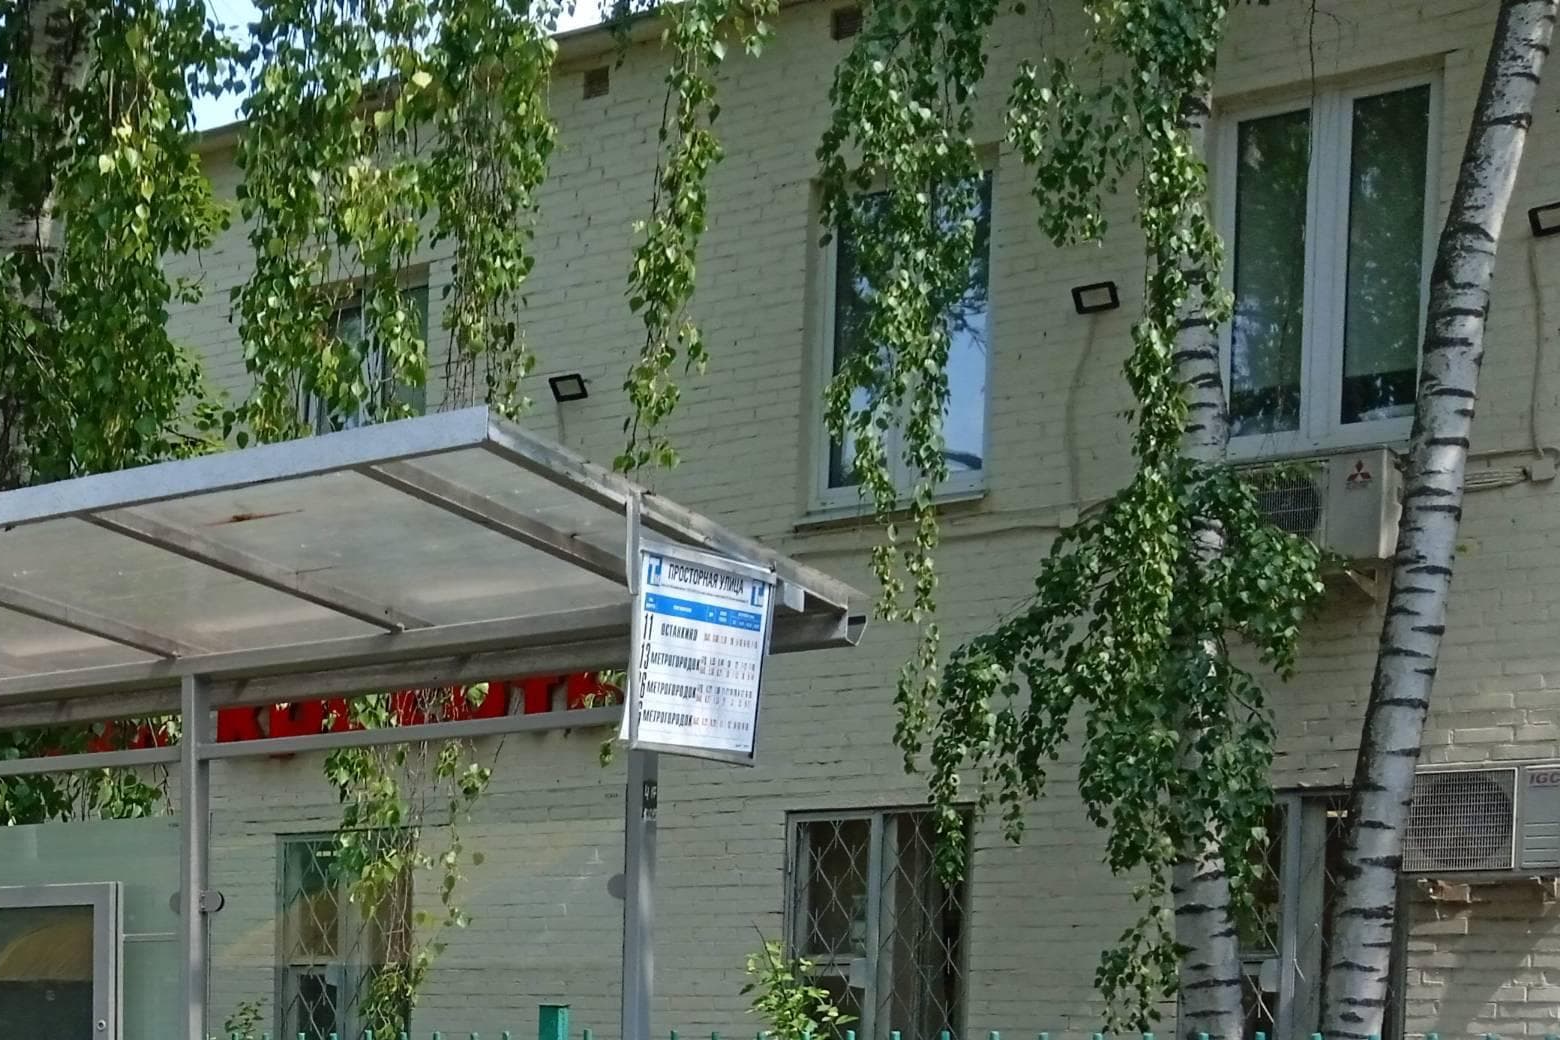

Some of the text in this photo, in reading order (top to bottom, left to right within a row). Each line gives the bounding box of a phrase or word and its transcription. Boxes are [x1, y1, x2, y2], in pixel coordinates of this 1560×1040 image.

[667, 563, 718, 588] ПРОСТОРНАЯ
[719, 574, 744, 596] УЛИЦА
[643, 613, 654, 641] 11
[661, 623, 698, 642] ОСТАНКИНО
[639, 642, 651, 670] 13
[651, 651, 700, 672] МЕТРОГОРОДОК
[646, 680, 697, 700] МЕТРОГОРОДОК
[642, 709, 693, 728] МЕТРОГОРОДОК
